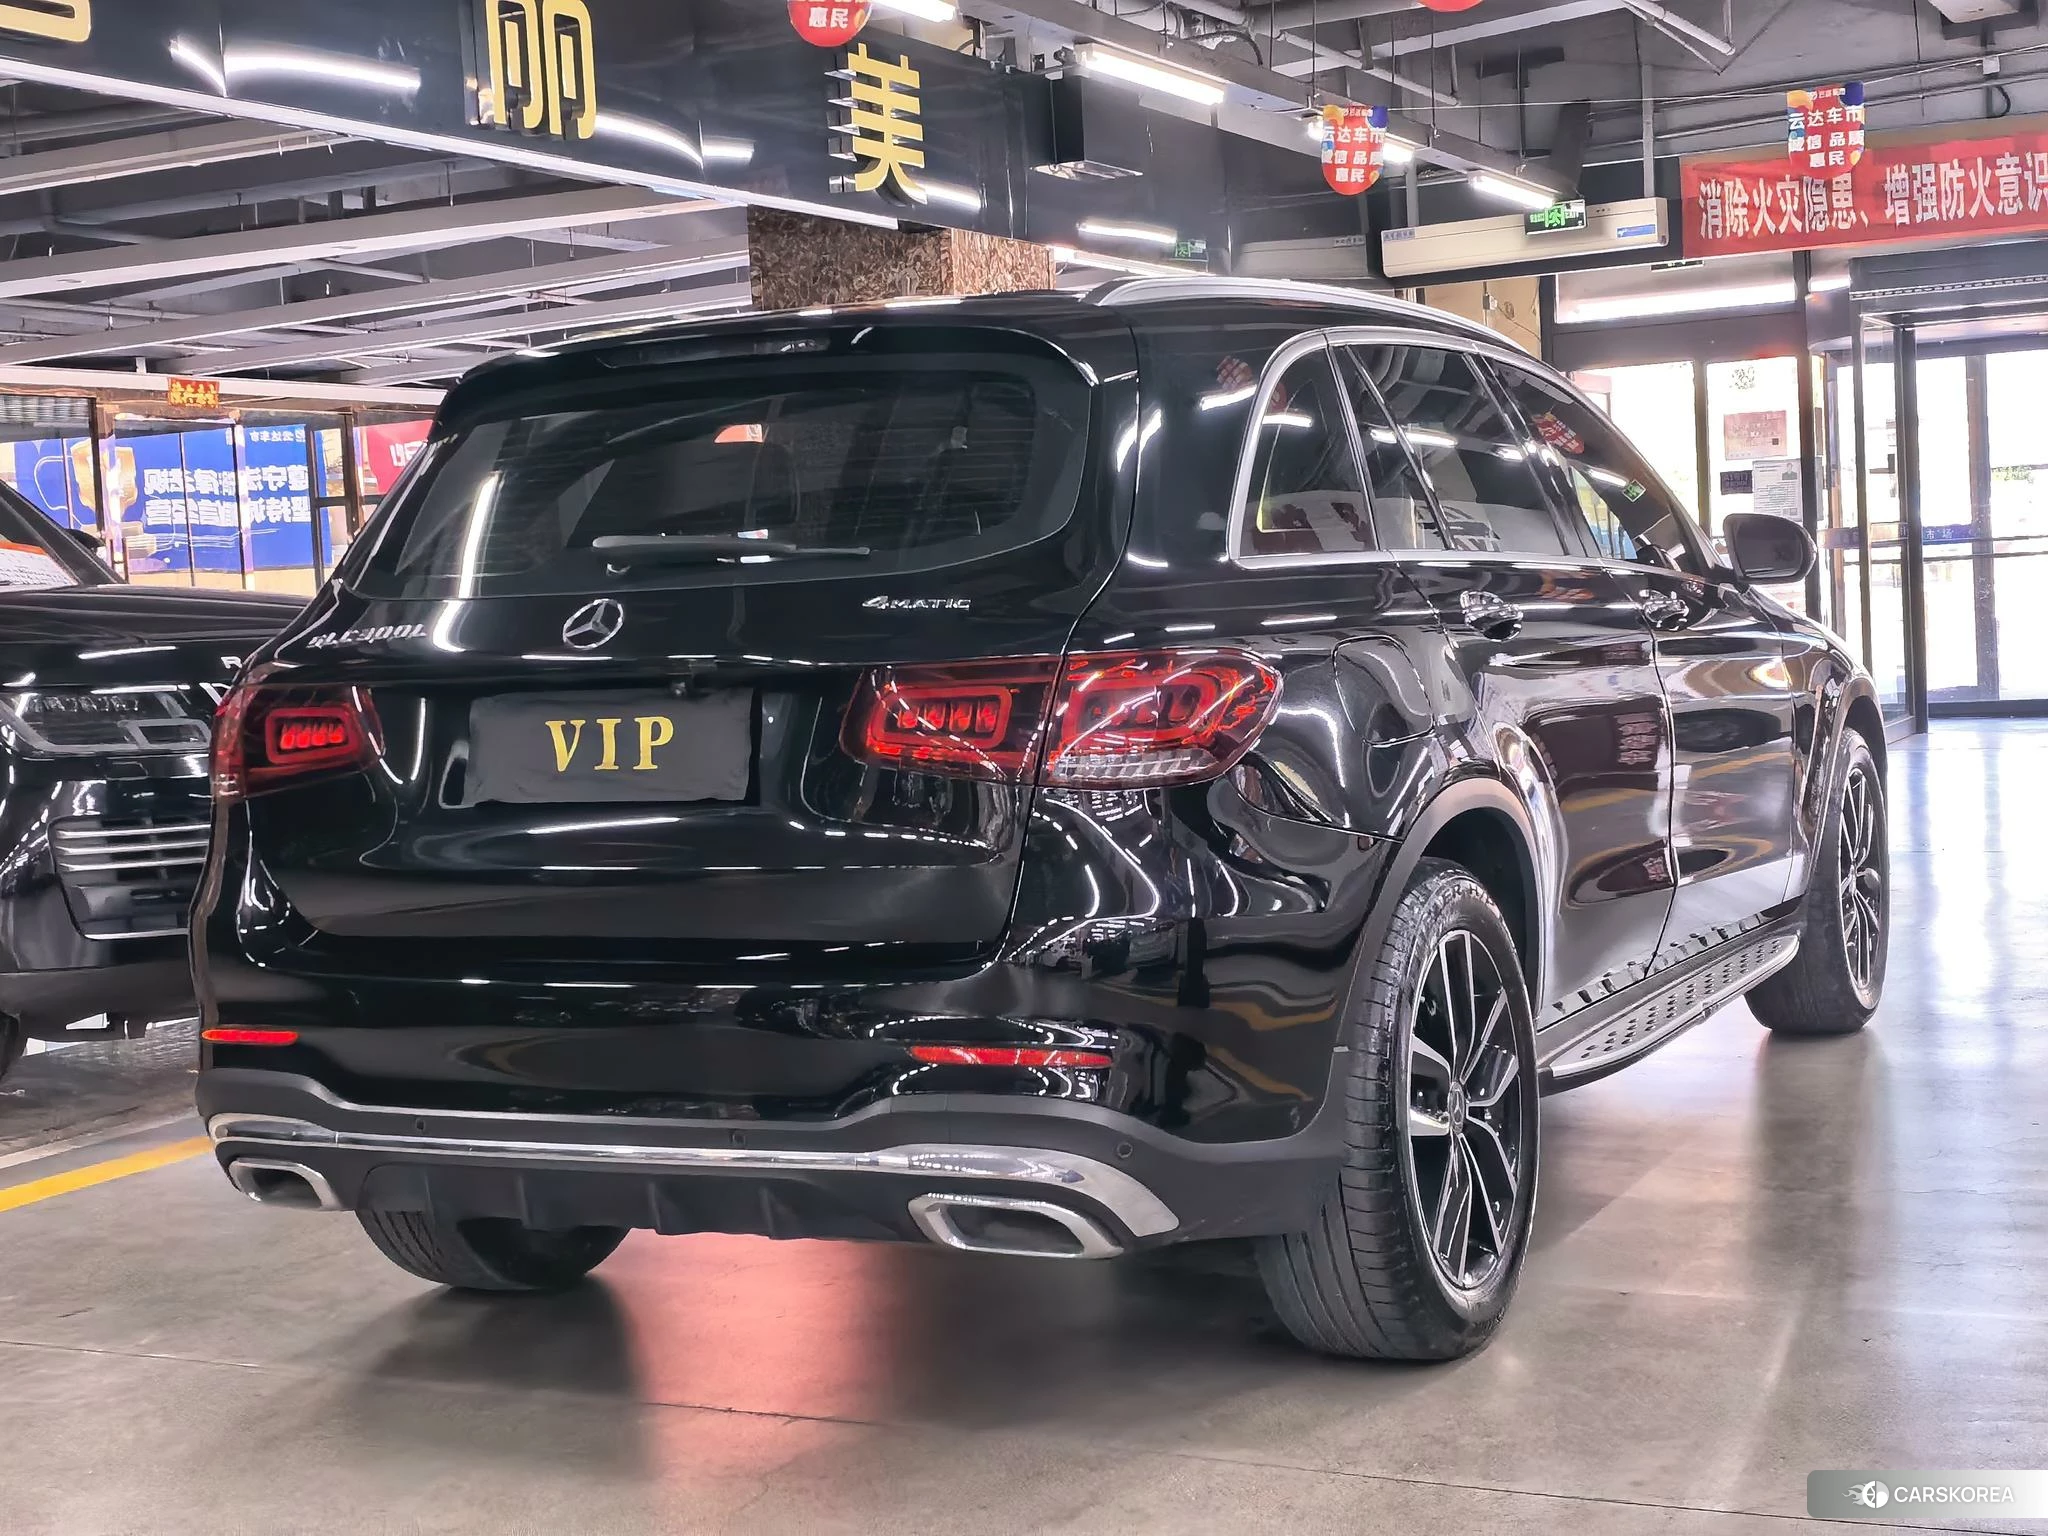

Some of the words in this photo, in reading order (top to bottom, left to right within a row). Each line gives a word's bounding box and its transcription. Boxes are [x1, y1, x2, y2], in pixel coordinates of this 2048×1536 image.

[846, 43, 927, 205] 美
[1788, 105, 1865, 130] 云达车市
[1323, 125, 1386, 144] 云达车市
[862, 595, 971, 610] 4MATIC
[545, 715, 674, 773] VIP
